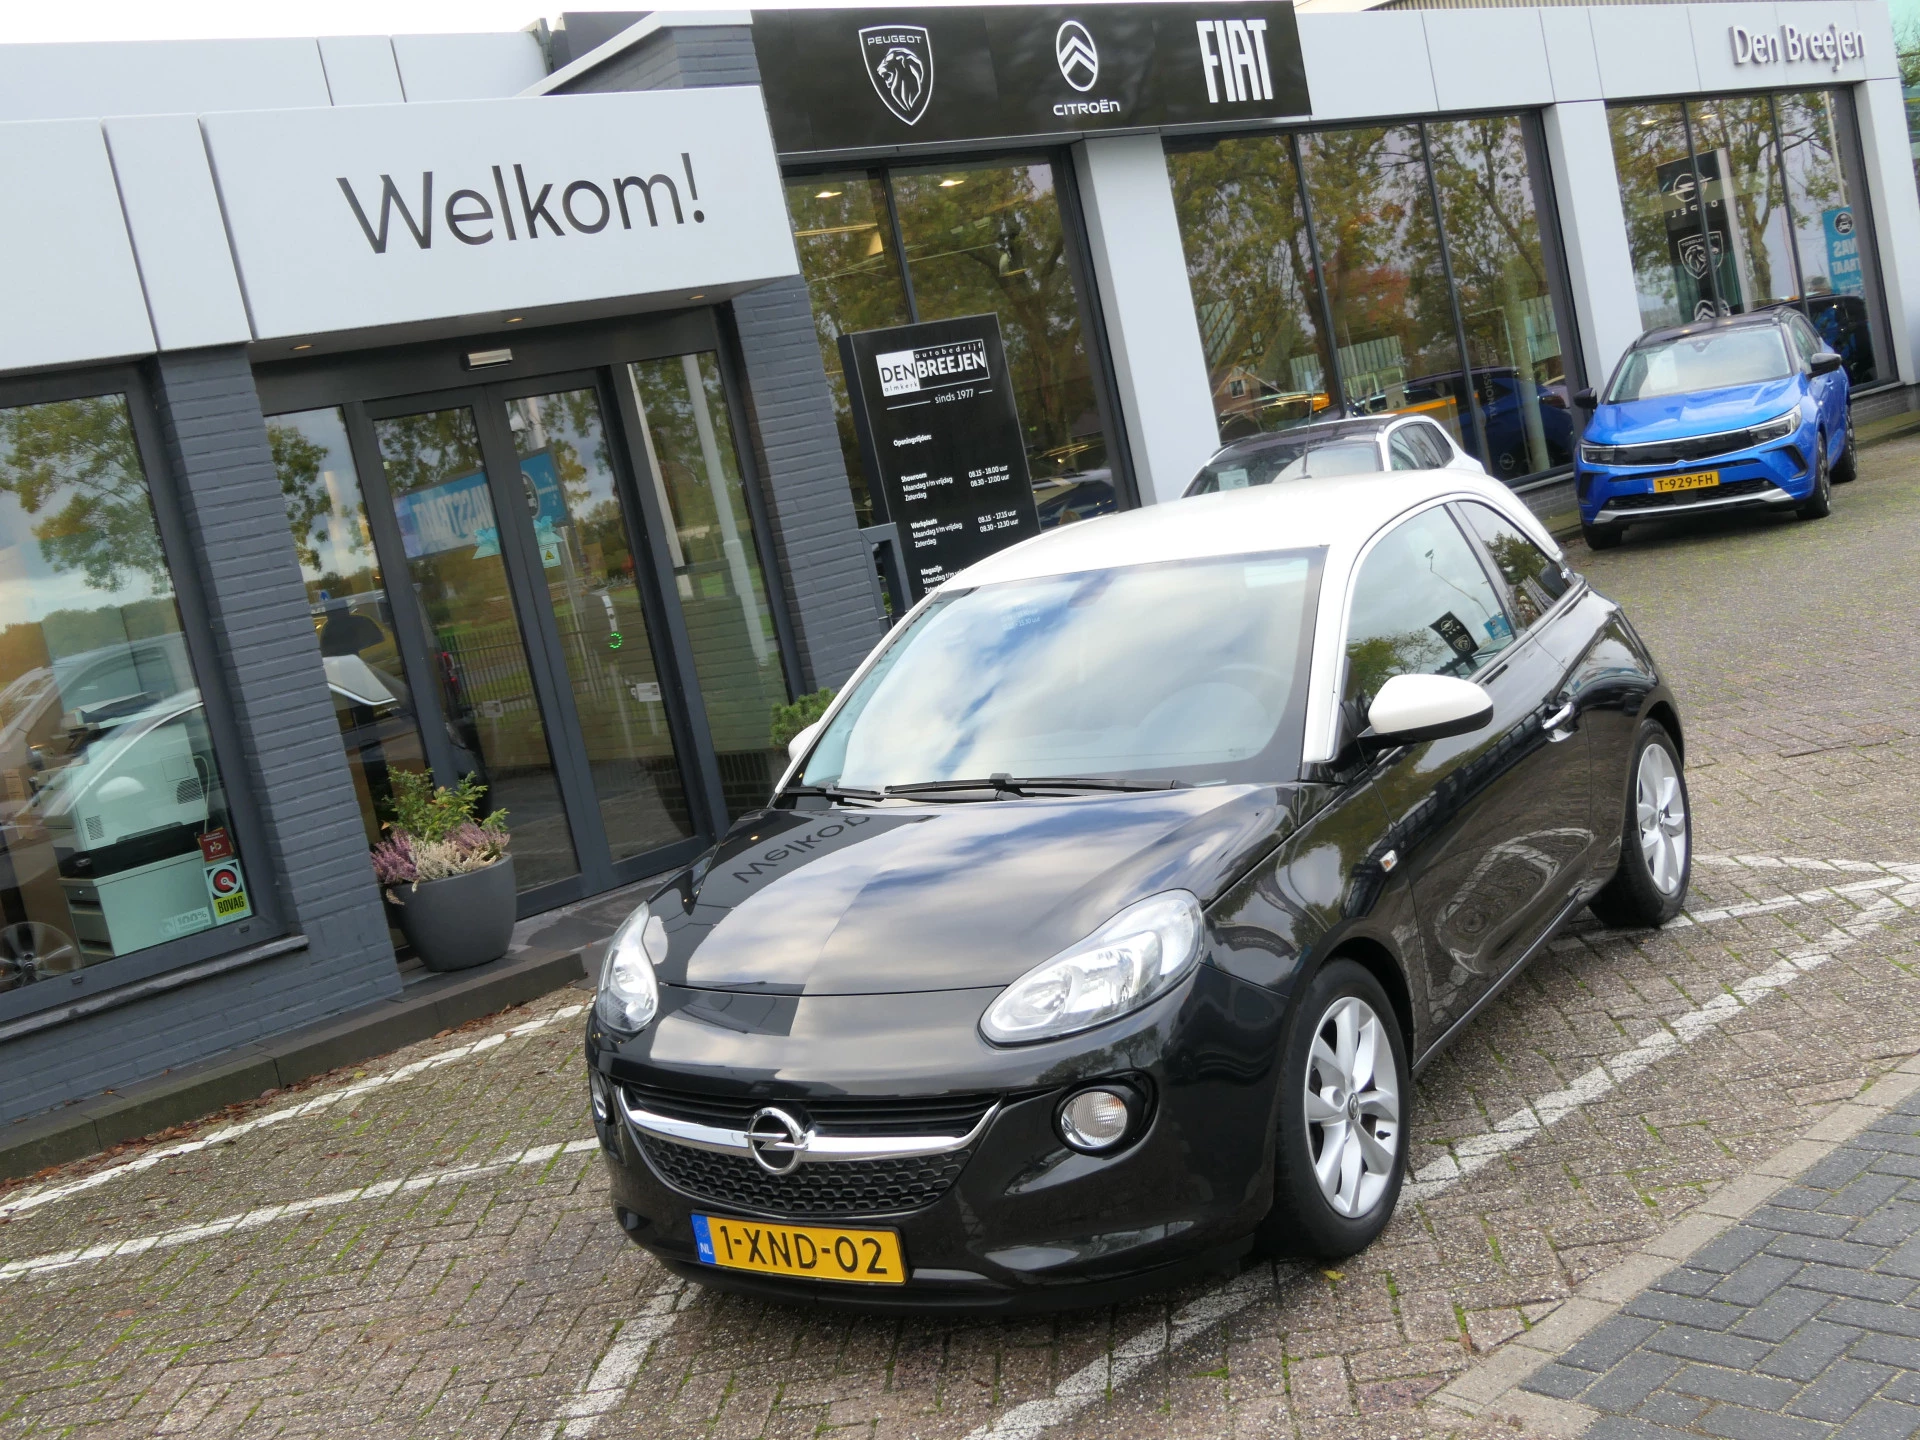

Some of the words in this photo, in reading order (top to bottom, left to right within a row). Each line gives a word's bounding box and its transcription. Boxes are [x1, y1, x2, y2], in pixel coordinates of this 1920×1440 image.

[867, 34, 922, 46] PEUGEOT
[1728, 24, 1780, 64] Den
[1780, 21, 1867, 72] Breejen
[1196, 19, 1274, 103] FIAT
[336, 152, 705, 255] Welkom!
[915, 342, 983, 359] autobedrijf
[881, 363, 917, 383] DEN
[917, 351, 986, 379] BREEJEN
[885, 382, 918, 393] almkerk
[934, 391, 956, 404] sinds
[957, 388, 974, 400] 1977
[901, 472, 928, 483] Showroom
[903, 481, 926, 492] Maandag
[936, 476, 953, 486] vrijdag
[1657, 474, 1713, 490] T-929-FH
[904, 491, 927, 502] Zaterdag
[911, 518, 938, 529] Werkplaats
[912, 528, 936, 539] Maandag
[945, 522, 963, 532] vrijdag
[915, 537, 937, 548] Zaterdag
[922, 574, 946, 584] Maandag
[217, 895, 245, 914] BOVAG
[700, 1242, 713, 1256] NL
[719, 1225, 888, 1275] 1-XND-02
